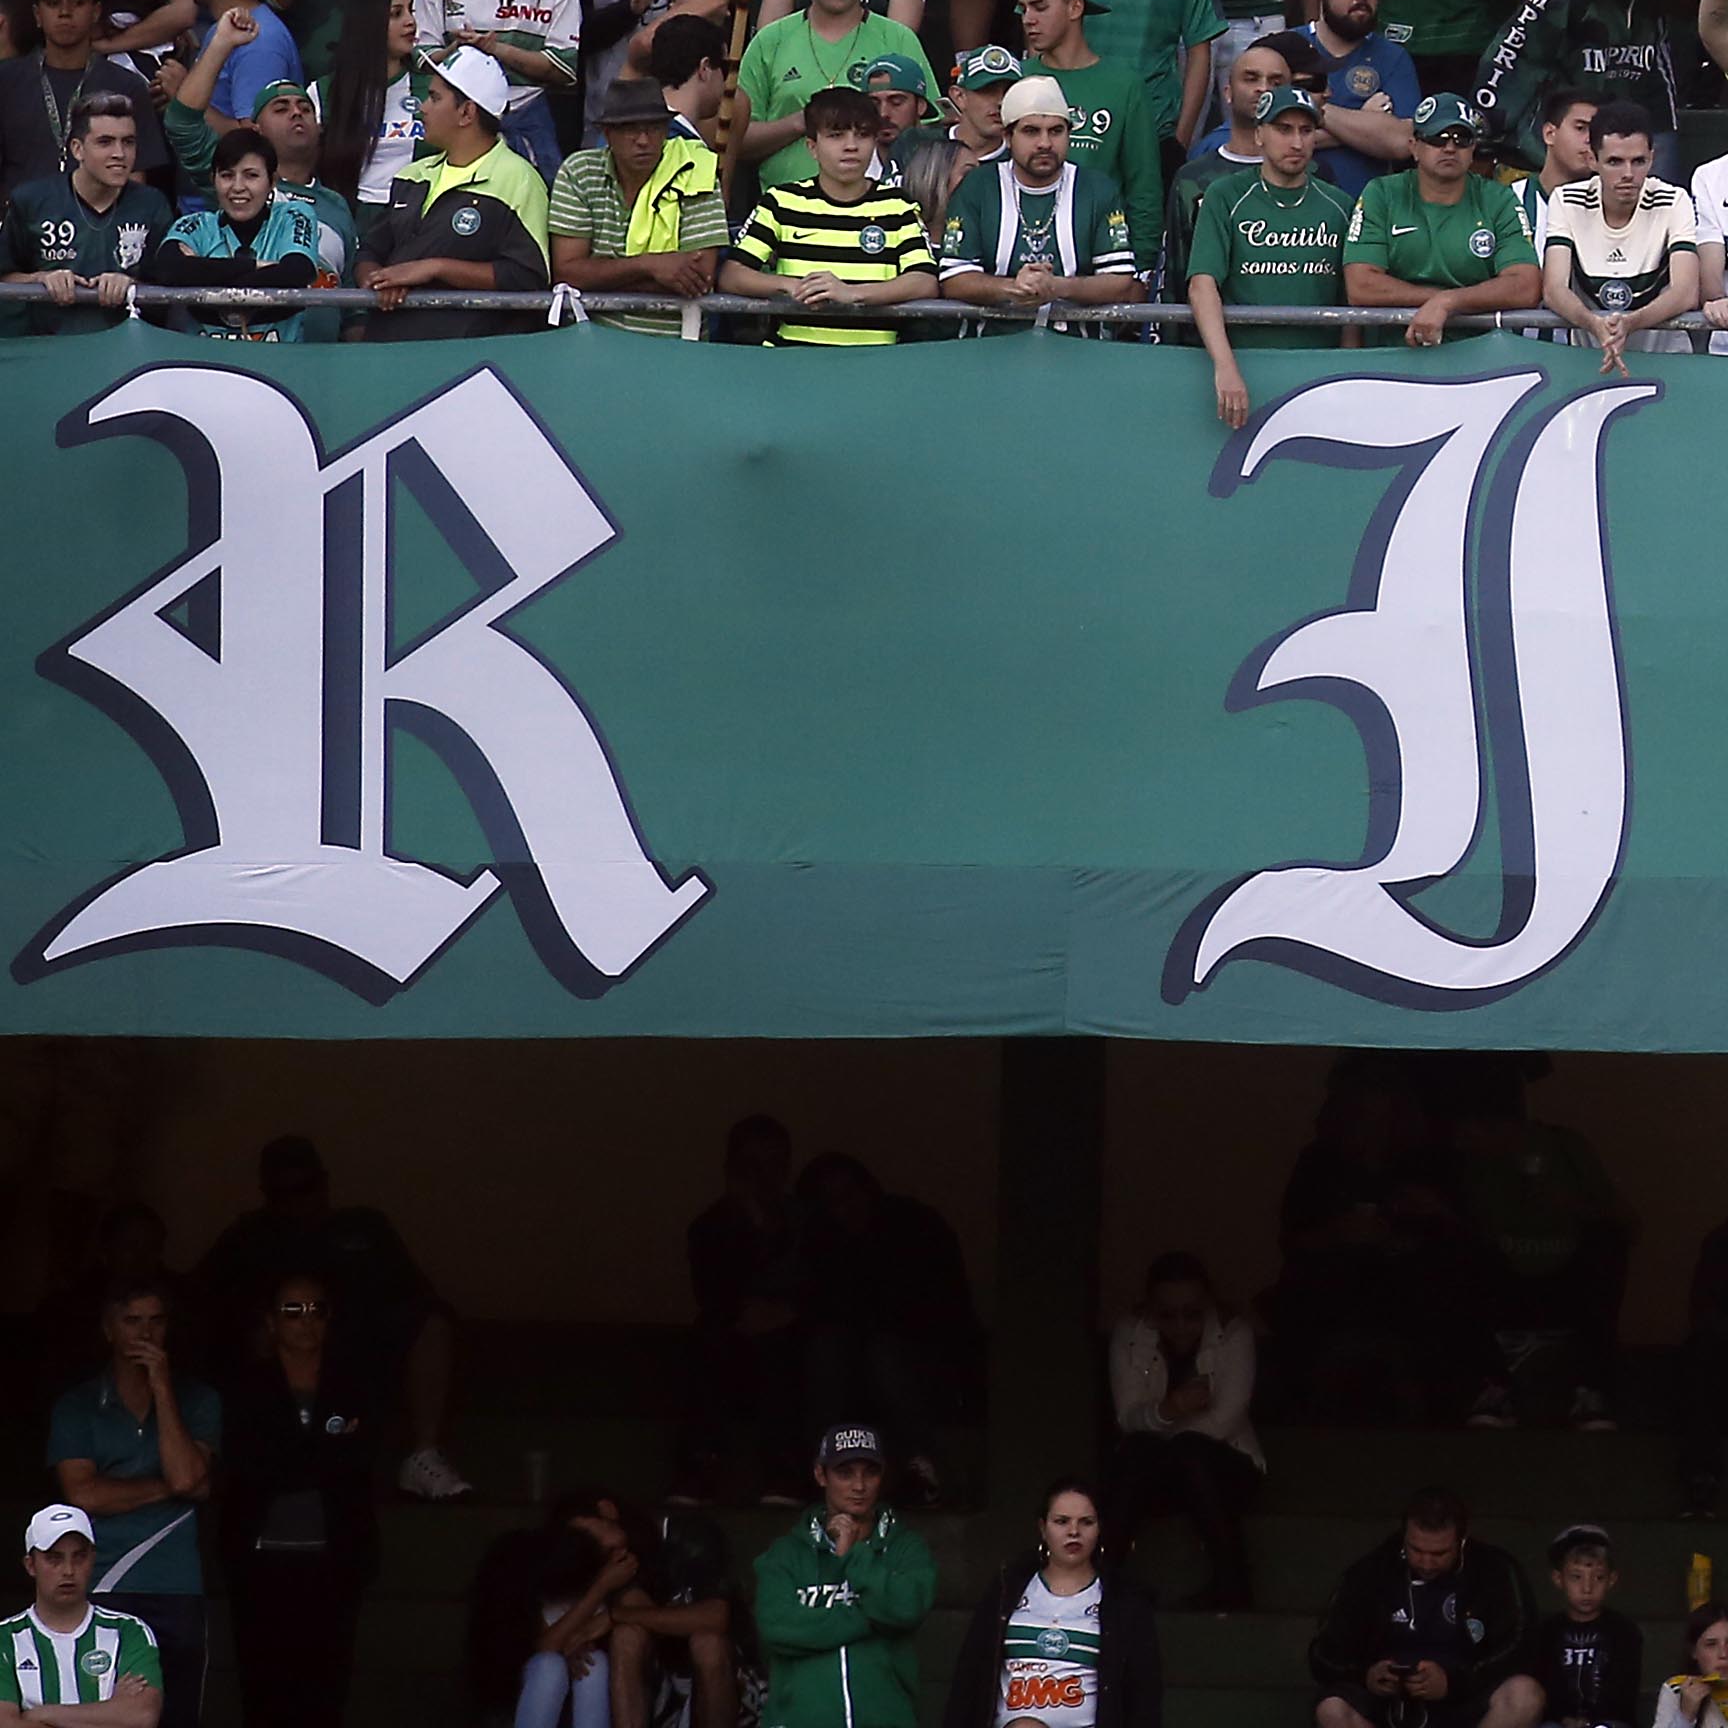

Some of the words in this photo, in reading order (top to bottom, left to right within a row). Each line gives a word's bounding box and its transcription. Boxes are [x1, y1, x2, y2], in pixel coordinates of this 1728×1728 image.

[495, 4, 552, 24] SANYO
[40, 219, 76, 248] 39
[1238, 219, 1341, 250] Coritiba
[1240, 259, 1299, 276] somos
[1006, 1675, 1085, 1711] BMG
